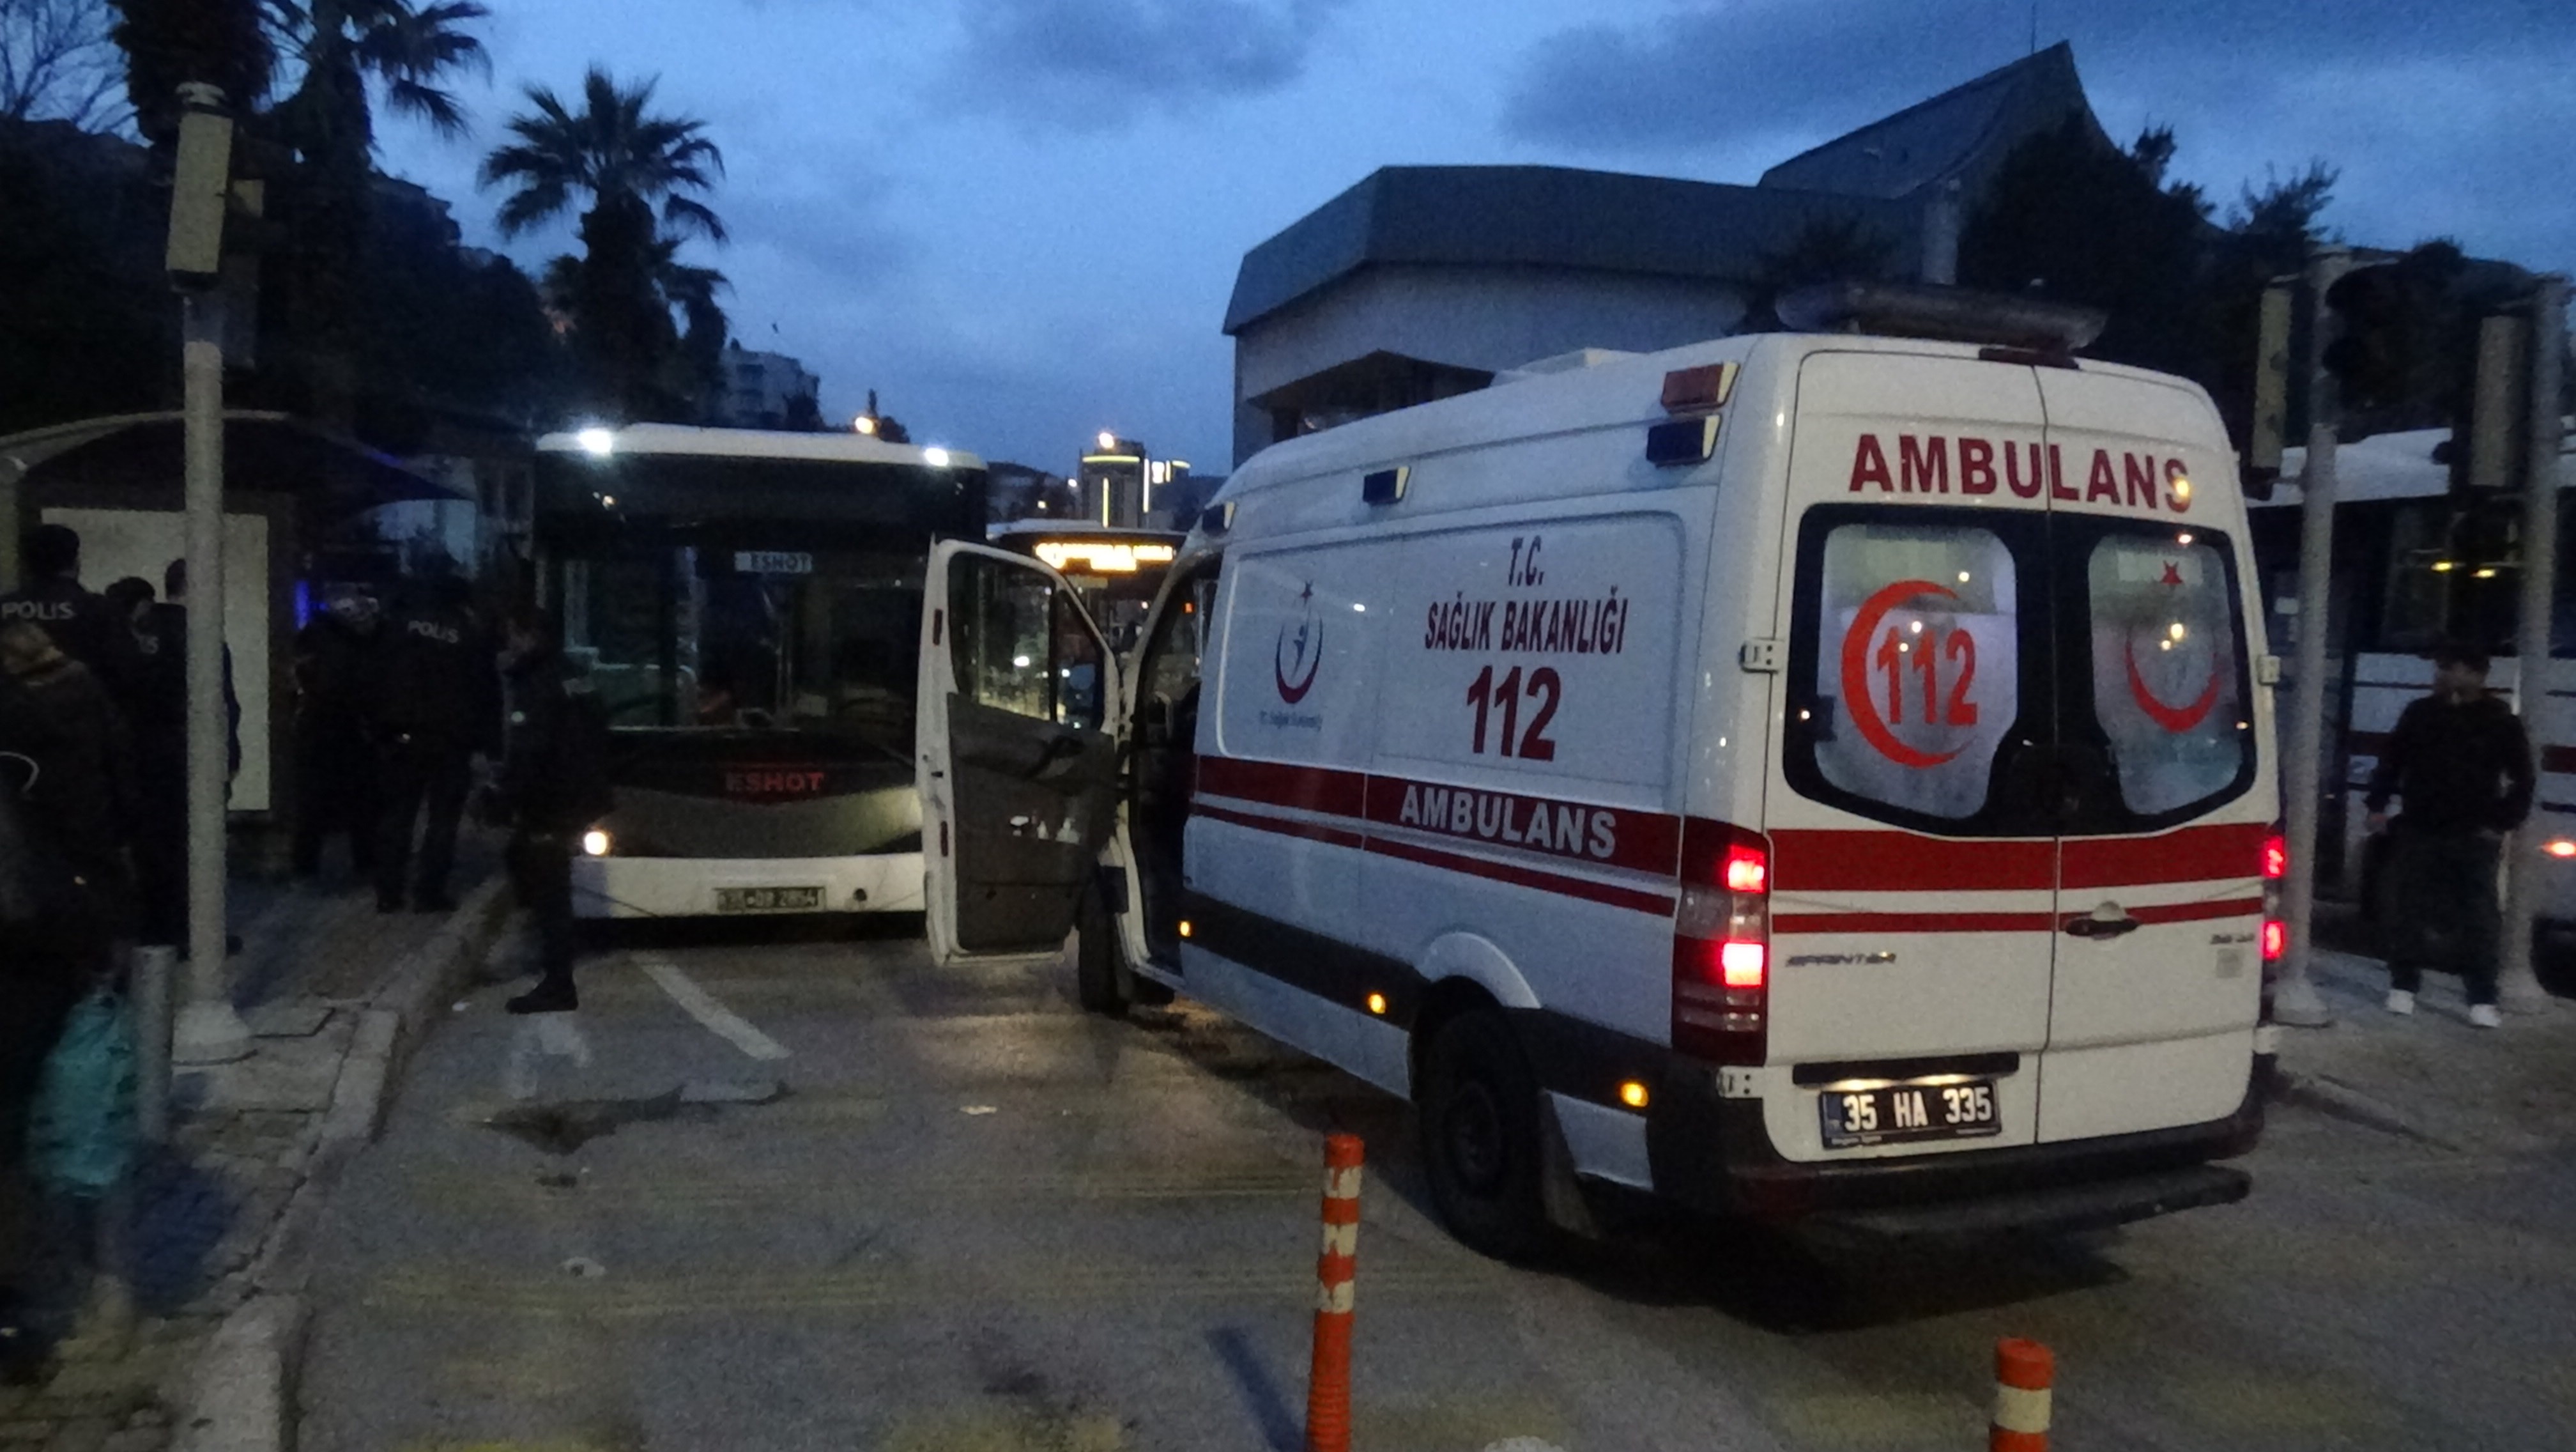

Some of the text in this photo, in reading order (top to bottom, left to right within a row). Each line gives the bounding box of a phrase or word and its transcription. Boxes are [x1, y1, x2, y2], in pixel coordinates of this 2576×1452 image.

[1849, 434, 2191, 513] AMBULANS
[751, 552, 811, 573] ESHOT
[1508, 535, 1545, 587] T.C.
[1425, 585, 1628, 654] SAĞLIK BAKANLIĞI
[1877, 625, 1977, 727] 112
[1467, 665, 1561, 762] 112
[725, 771, 825, 792] ESHOT
[1400, 784, 1616, 858] AMBULANS
[1843, 1086, 1991, 1131] 35 HA 335
